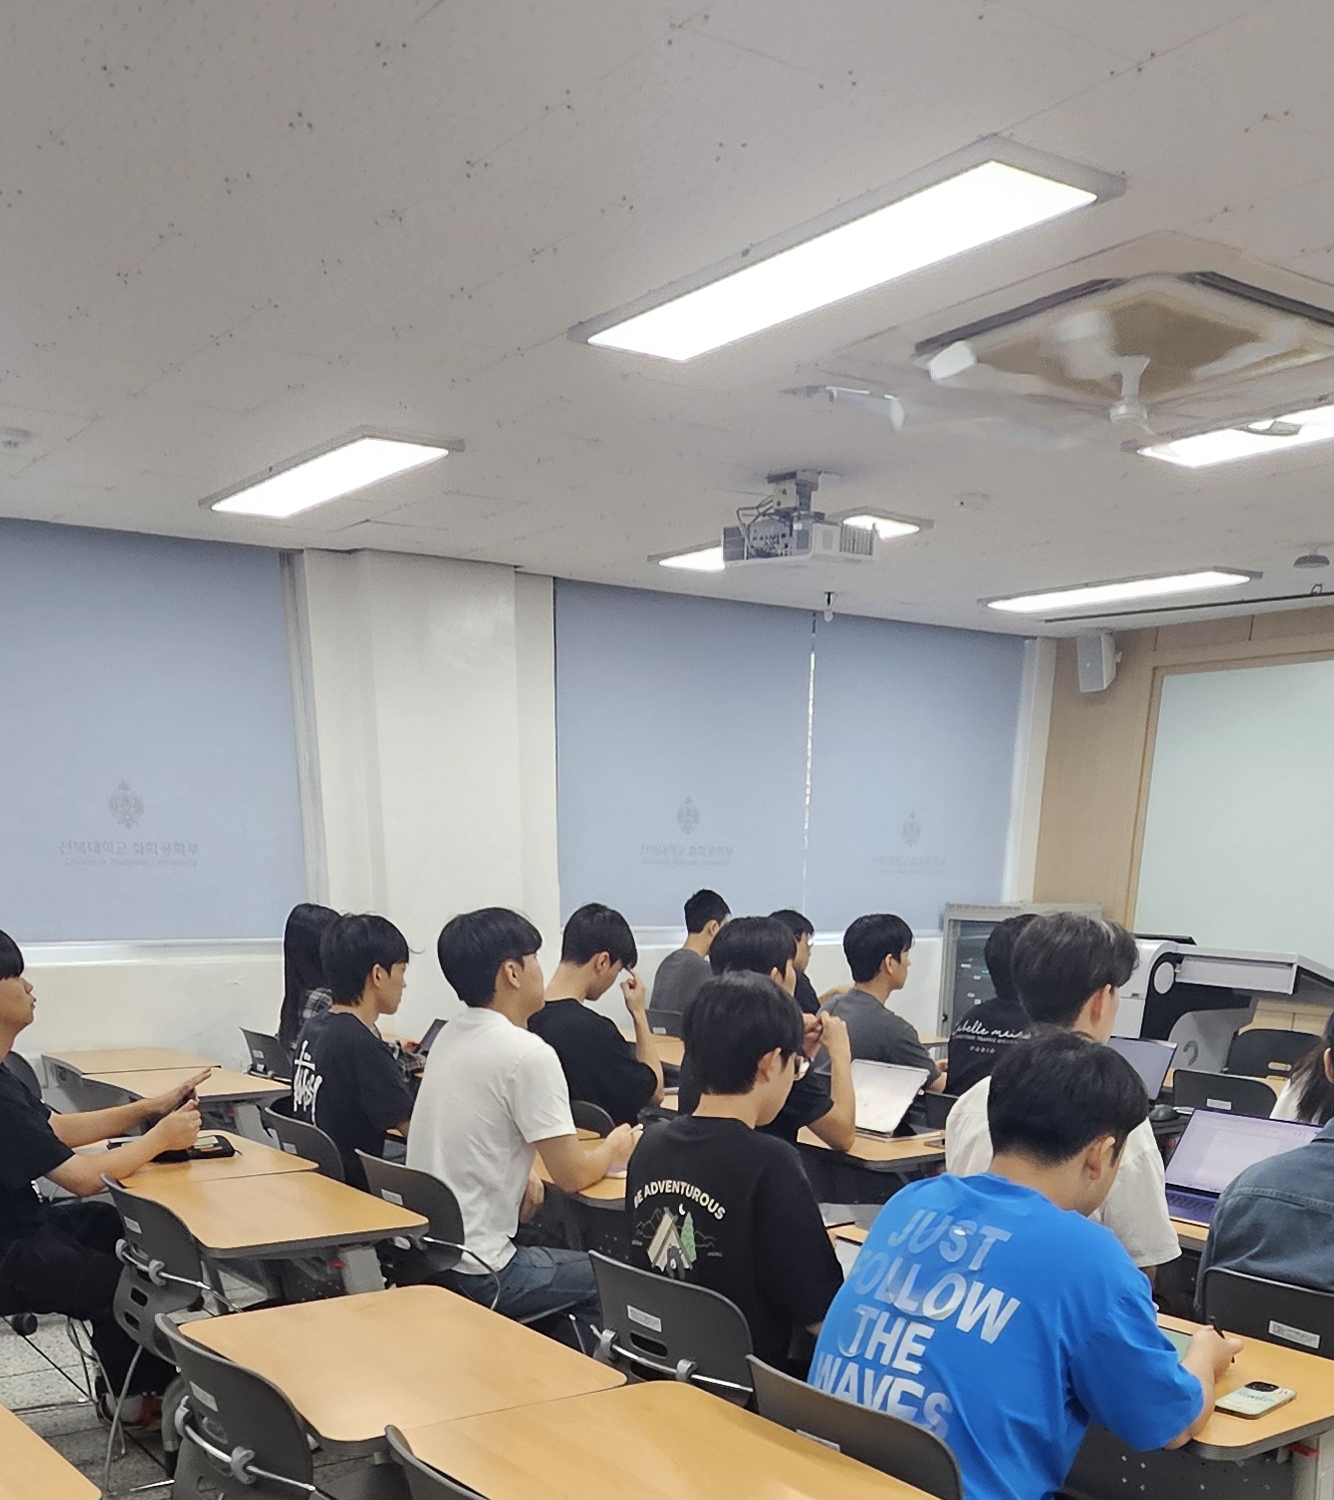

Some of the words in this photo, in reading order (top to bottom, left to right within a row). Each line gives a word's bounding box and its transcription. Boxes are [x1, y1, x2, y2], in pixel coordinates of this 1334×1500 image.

[644, 1179, 726, 1220] ADVENTUROUS
[887, 1208, 1013, 1271] JUST
[848, 1303, 936, 1375] THE
[815, 1351, 953, 1440] WAVES
